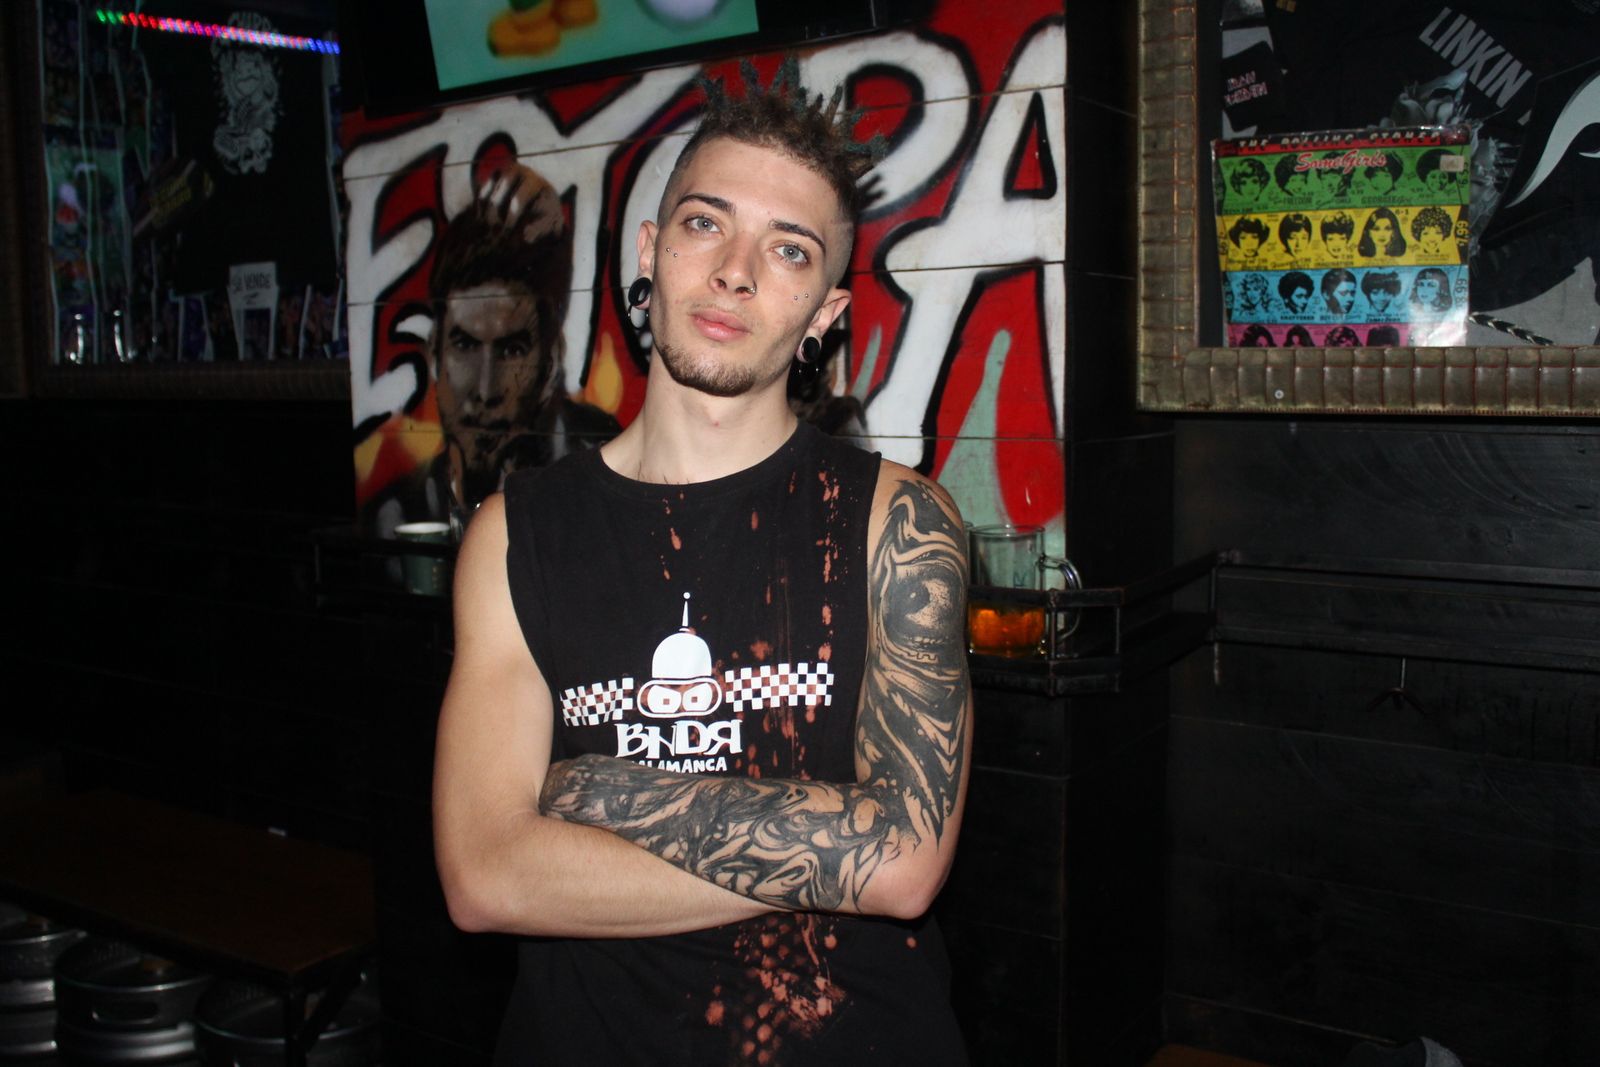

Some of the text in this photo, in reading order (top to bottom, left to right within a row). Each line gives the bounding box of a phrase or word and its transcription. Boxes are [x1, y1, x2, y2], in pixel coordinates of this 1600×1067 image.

[1418, 6, 1534, 109] LINKIN
[1239, 131, 1441, 152] THE ROLLING STONES
[631, 756, 728, 773] LAMANCA
